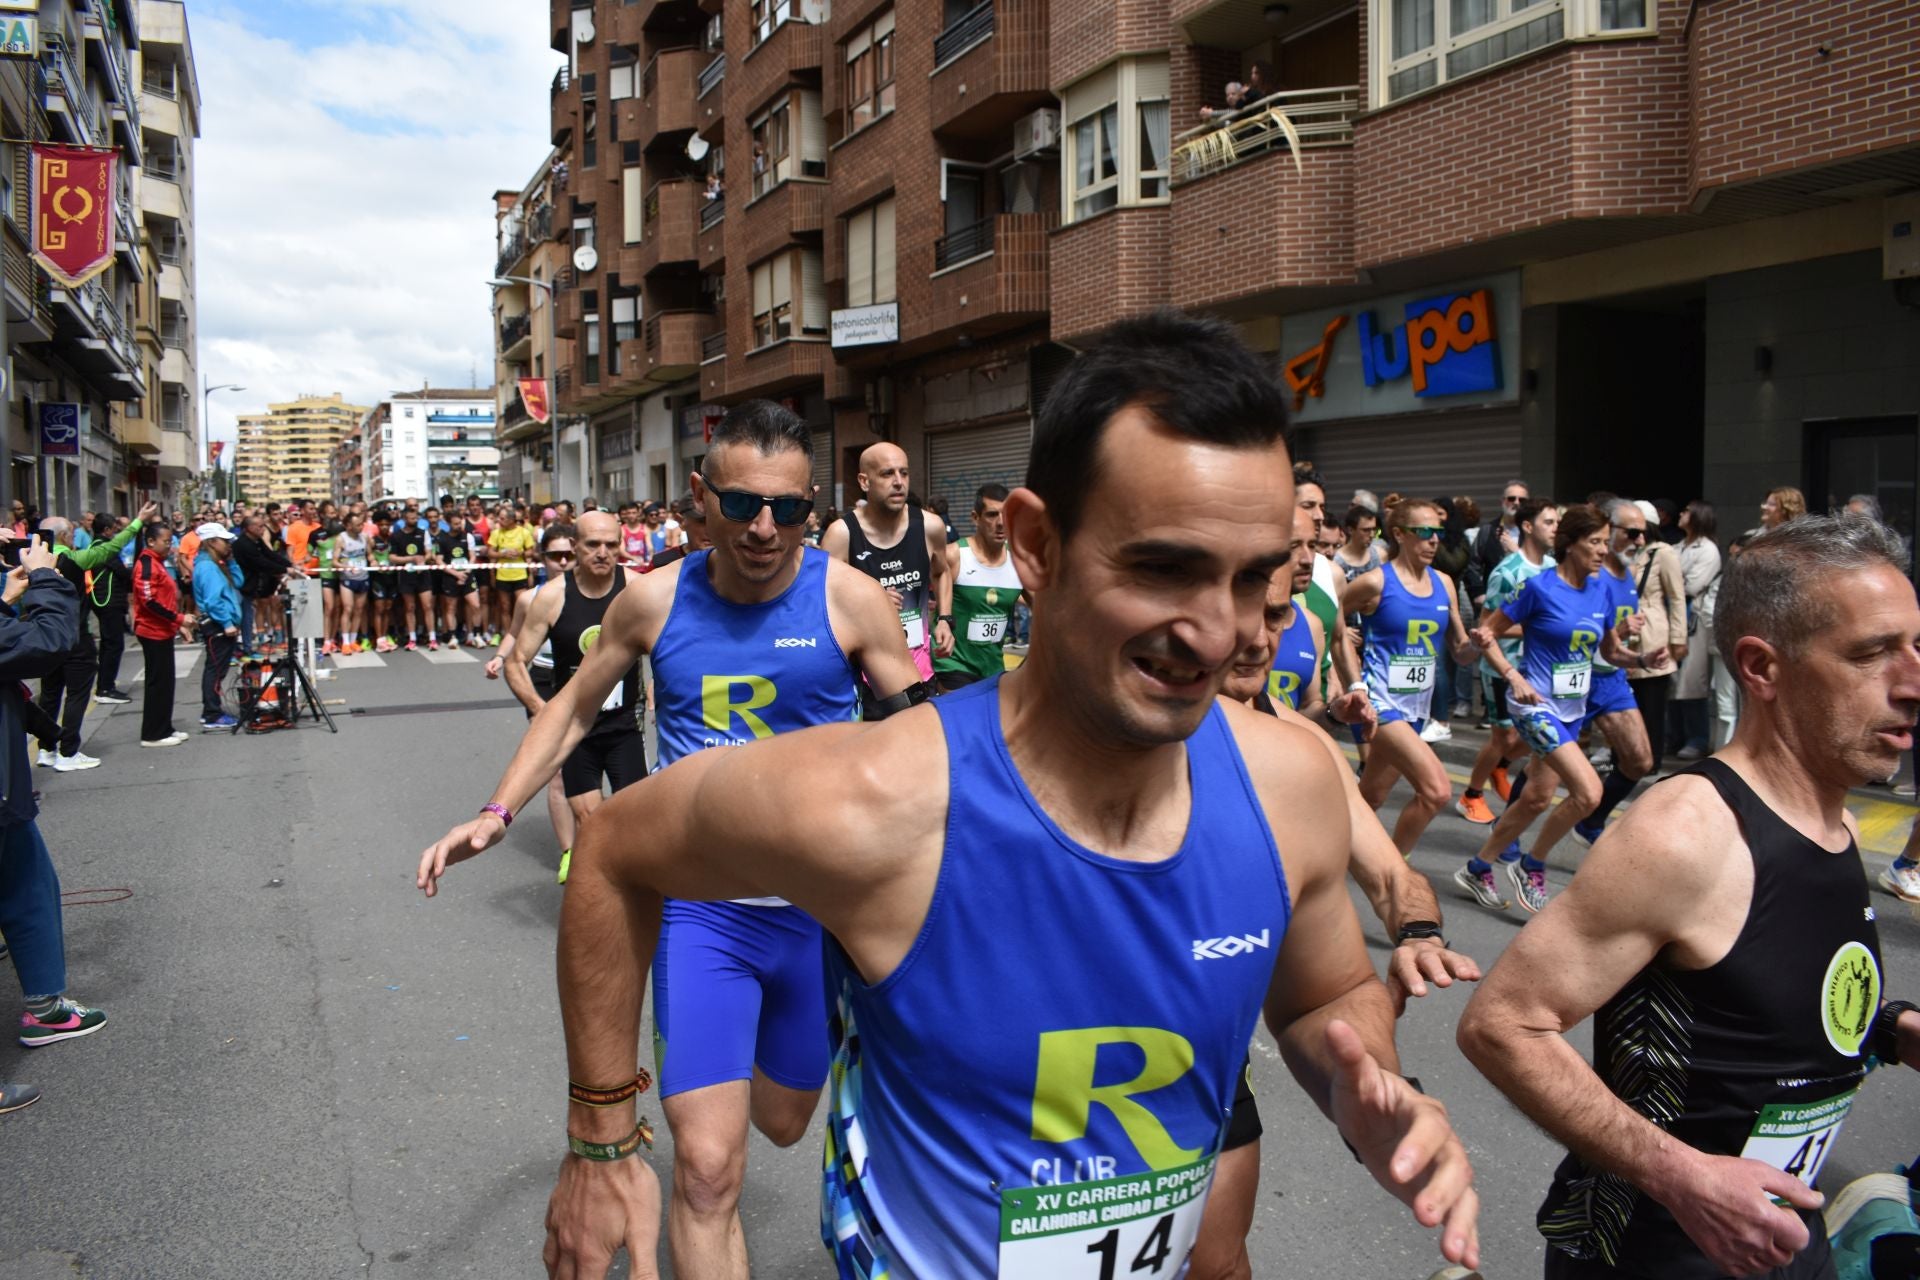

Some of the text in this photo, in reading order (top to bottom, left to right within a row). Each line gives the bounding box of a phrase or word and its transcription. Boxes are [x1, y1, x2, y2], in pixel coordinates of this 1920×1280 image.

[0, 42, 18, 52] ISO
[97, 162, 106, 253] PASO VIVIENTE
[1358, 289, 1494, 392] lupa
[880, 571, 920, 586] BARCO
[982, 623, 998, 637] 36
[1406, 619, 1439, 656] R
[1569, 629, 1597, 660] R
[1268, 670, 1301, 710] R
[1406, 667, 1426, 683] 48
[1569, 672, 1585, 689] 47
[702, 675, 777, 740] R
[1030, 1026, 1204, 1172] R
[1031, 1155, 1117, 1187] CLUB
[1784, 1128, 1831, 1177] 41
[1011, 1188, 1188, 1235] CALAHORRA CIUDAD DE LA
[1036, 1193, 1062, 1211] XV
[1066, 1180, 1152, 1207] CARRERA
[1087, 1212, 1175, 1280] 14
